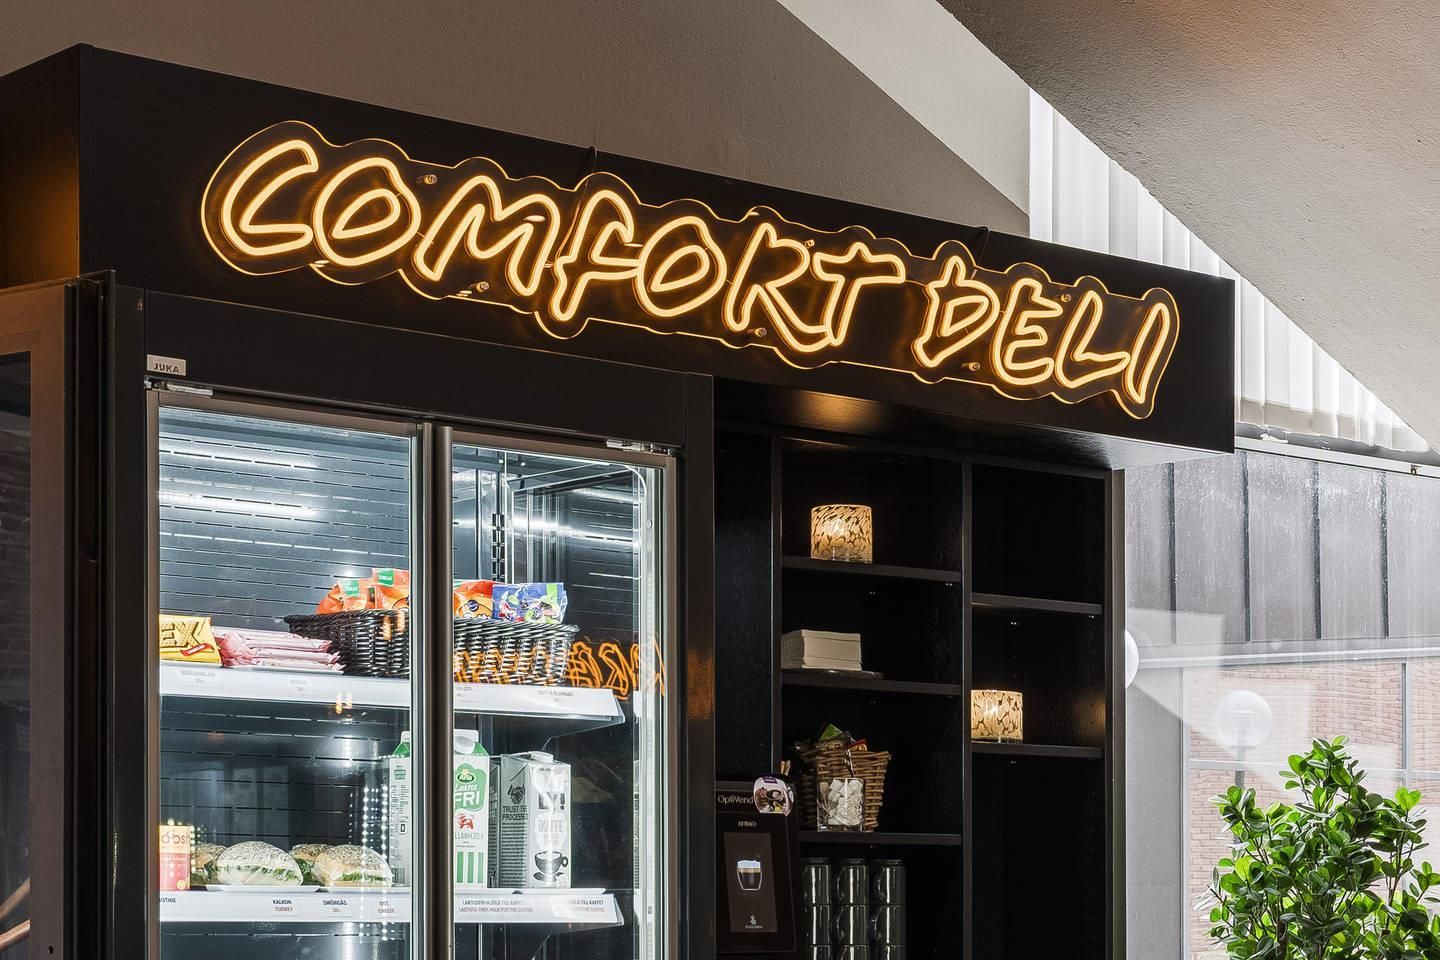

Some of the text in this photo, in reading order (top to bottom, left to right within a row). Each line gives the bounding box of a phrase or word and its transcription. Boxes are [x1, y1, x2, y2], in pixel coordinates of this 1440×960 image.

[220, 139, 1176, 407] COMFORT DELI
[153, 362, 180, 374] JUKA
[717, 794, 754, 805] OptiVend
